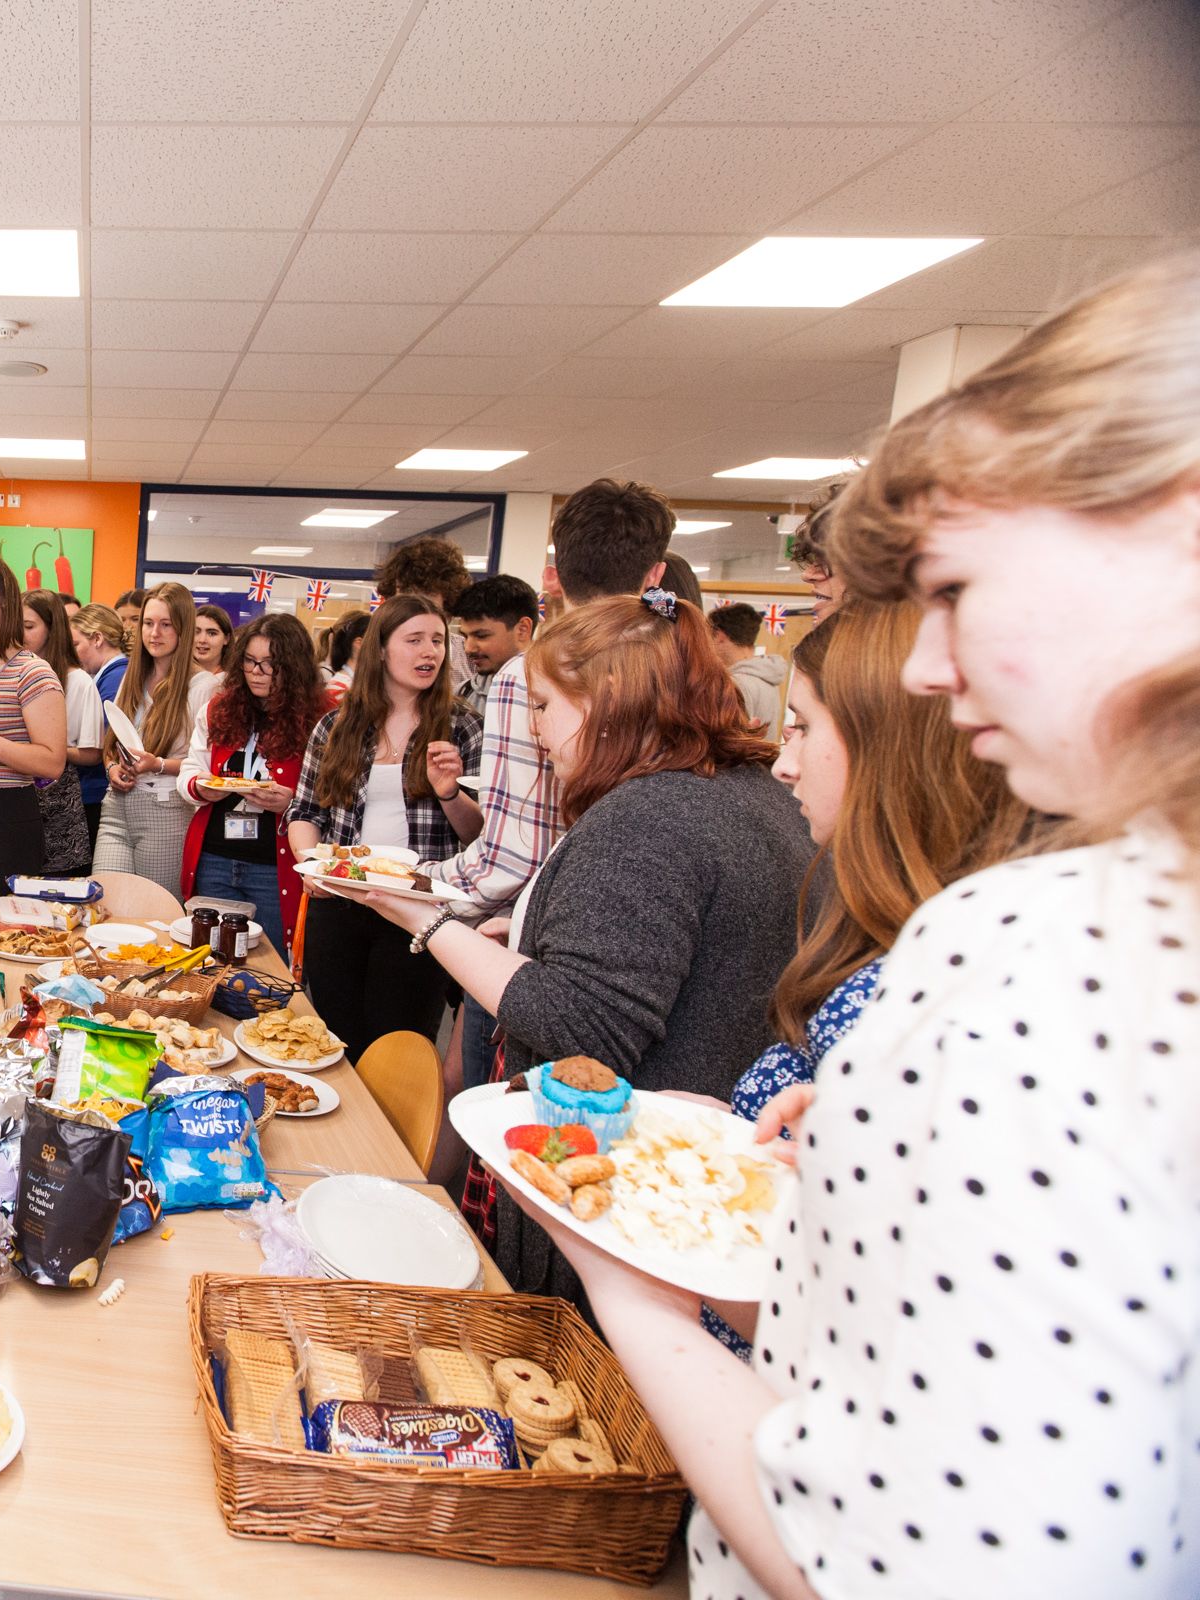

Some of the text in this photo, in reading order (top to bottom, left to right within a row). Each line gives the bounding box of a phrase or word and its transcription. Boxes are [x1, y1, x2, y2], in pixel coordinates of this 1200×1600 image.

[183, 1096, 239, 1112] inegar
[179, 1119, 242, 1138] TWISTS
[32, 1185, 50, 1200] Lightly
[28, 1203, 46, 1216] Crisps
[35, 1197, 55, 1210] Salted
[391, 1412, 479, 1438] Digestives
